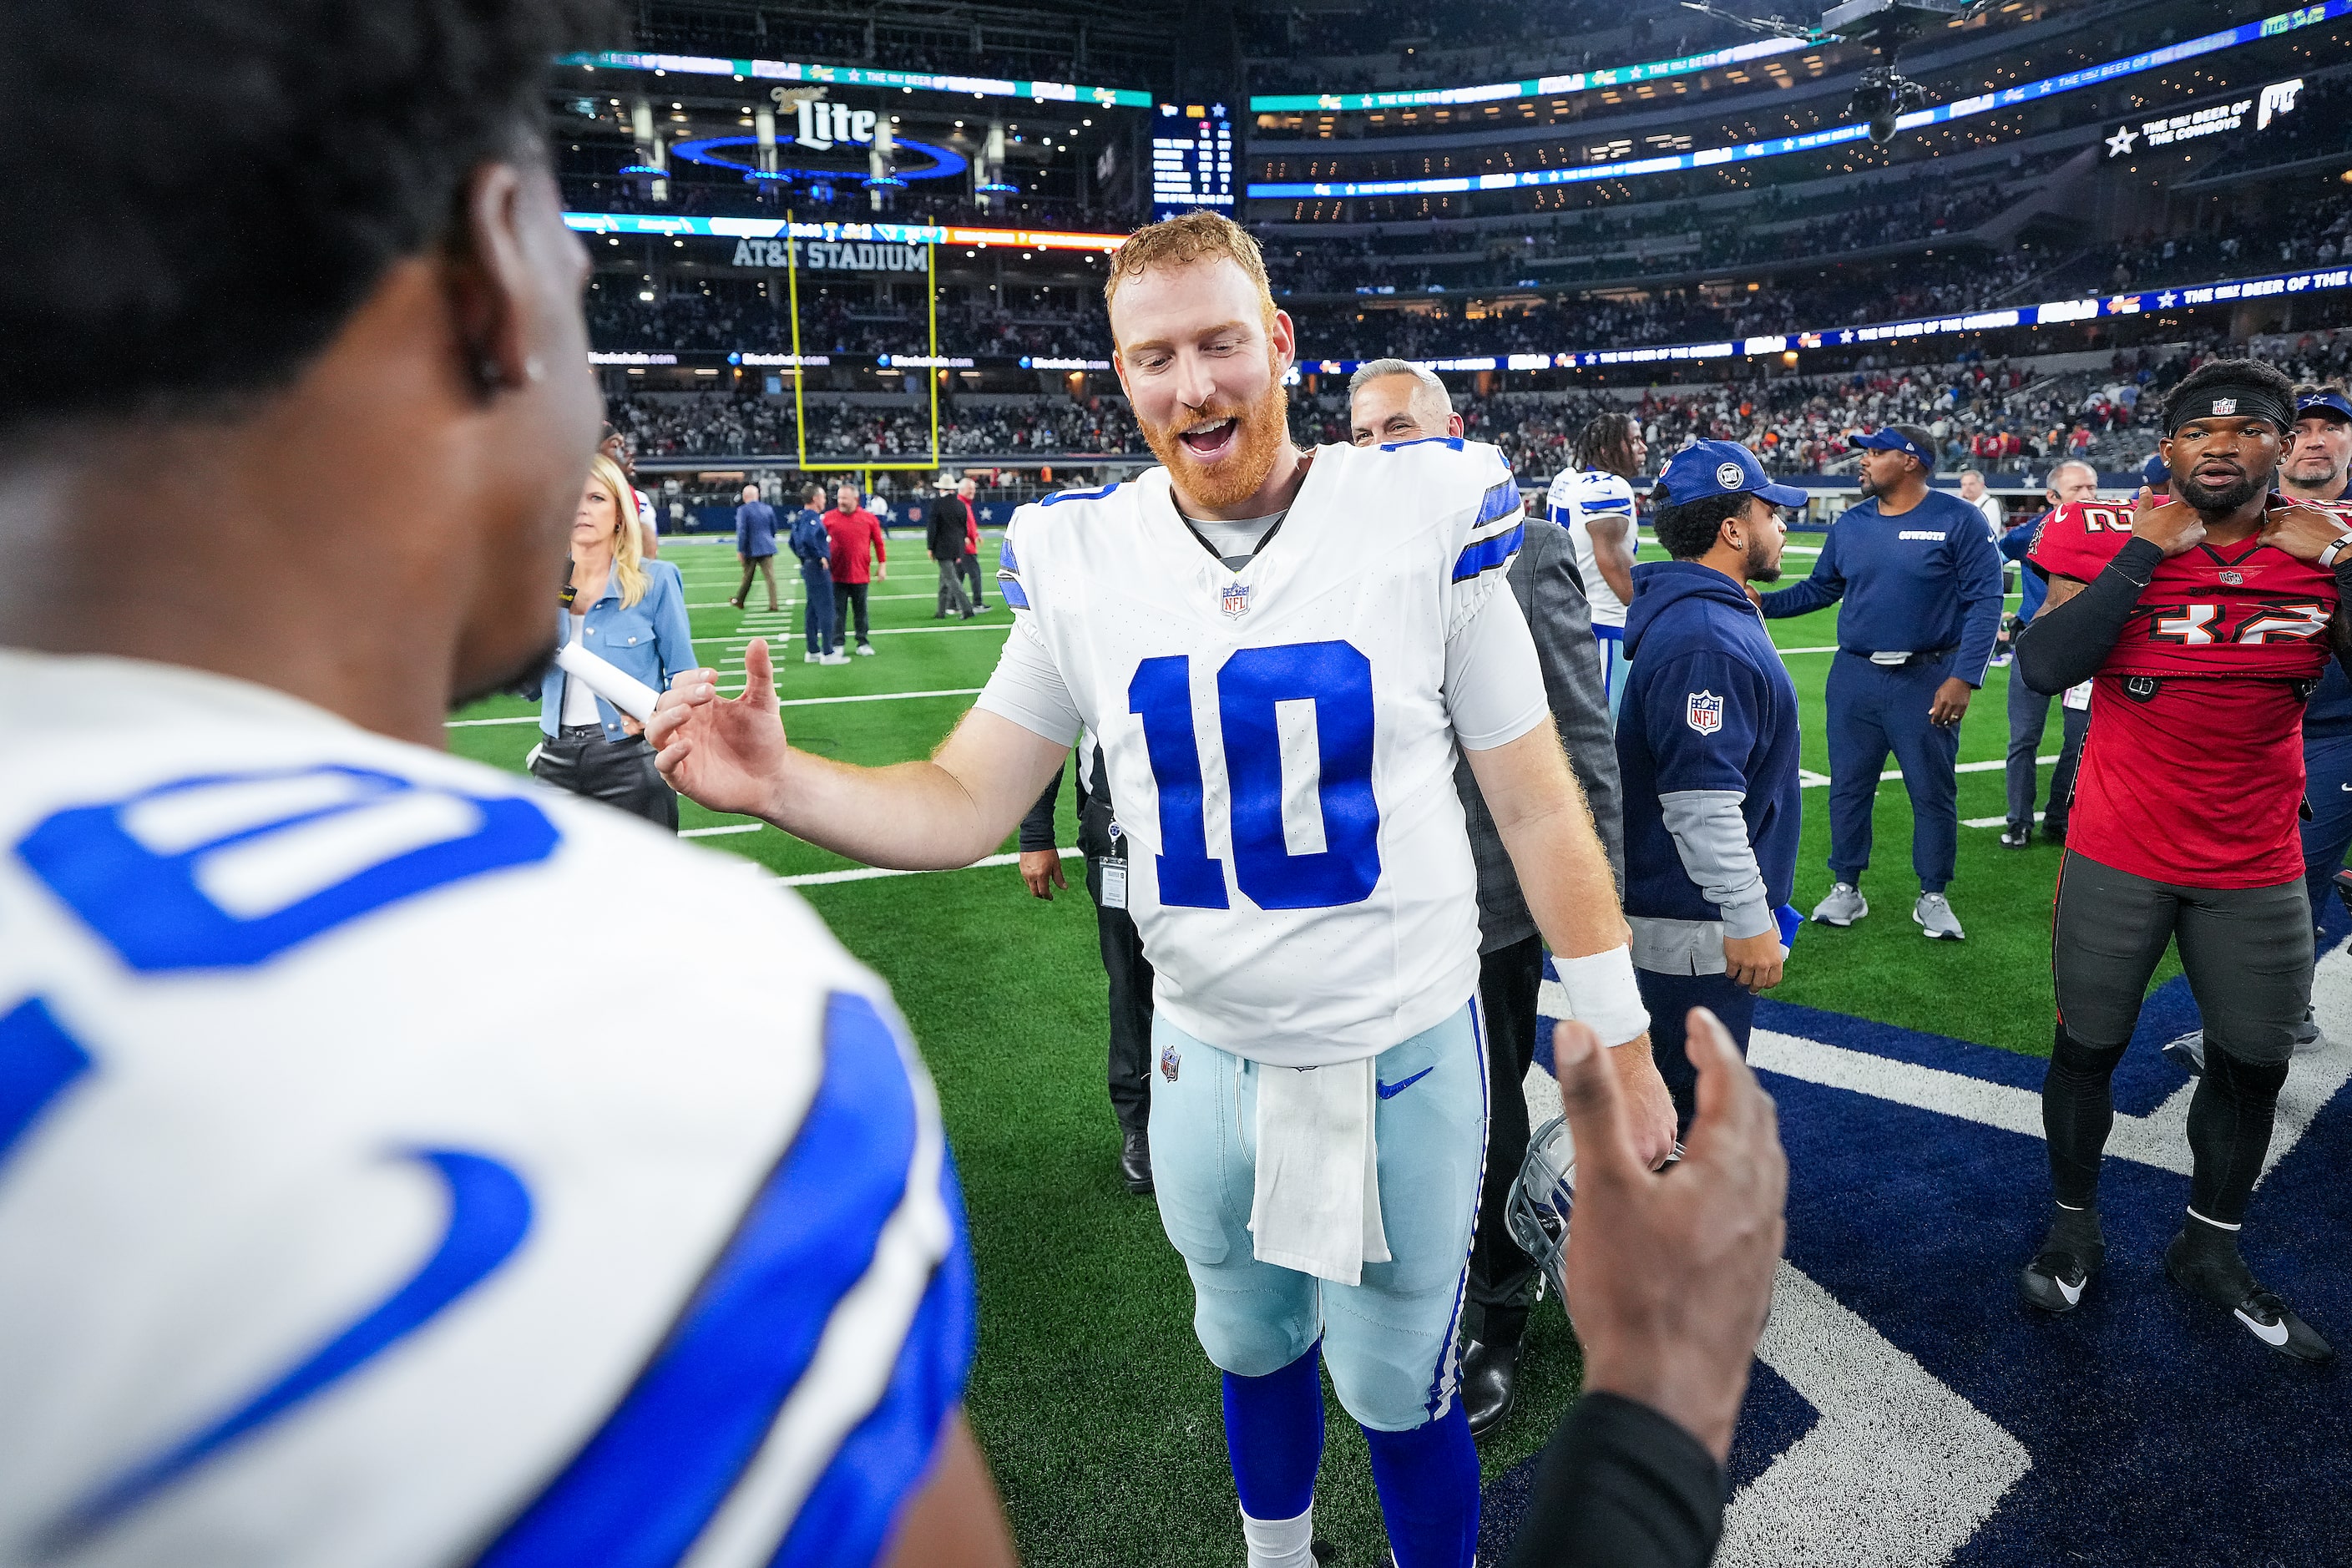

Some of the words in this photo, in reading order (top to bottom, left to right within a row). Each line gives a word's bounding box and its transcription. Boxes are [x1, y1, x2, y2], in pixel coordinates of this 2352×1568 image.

[793, 99, 877, 152] Lite
[2142, 119, 2169, 136] THE
[2192, 104, 2230, 124] BEER
[2230, 99, 2253, 116] OF
[2147, 129, 2175, 147] THE
[2175, 115, 2242, 141] COWBOYS
[731, 239, 802, 268] AT&T
[807, 241, 929, 272] STADIUM
[2183, 287, 2214, 304] THE
[2241, 279, 2284, 298] BEER
[2286, 276, 2311, 292] OF
[2312, 271, 2348, 289] THE
[1898, 530, 1947, 542] COWBOYS
[1225, 596, 1246, 612] NFL
[1692, 709, 1717, 727] NFL
[1127, 639, 1382, 911] 10
[1161, 1060, 1176, 1077] NFL
